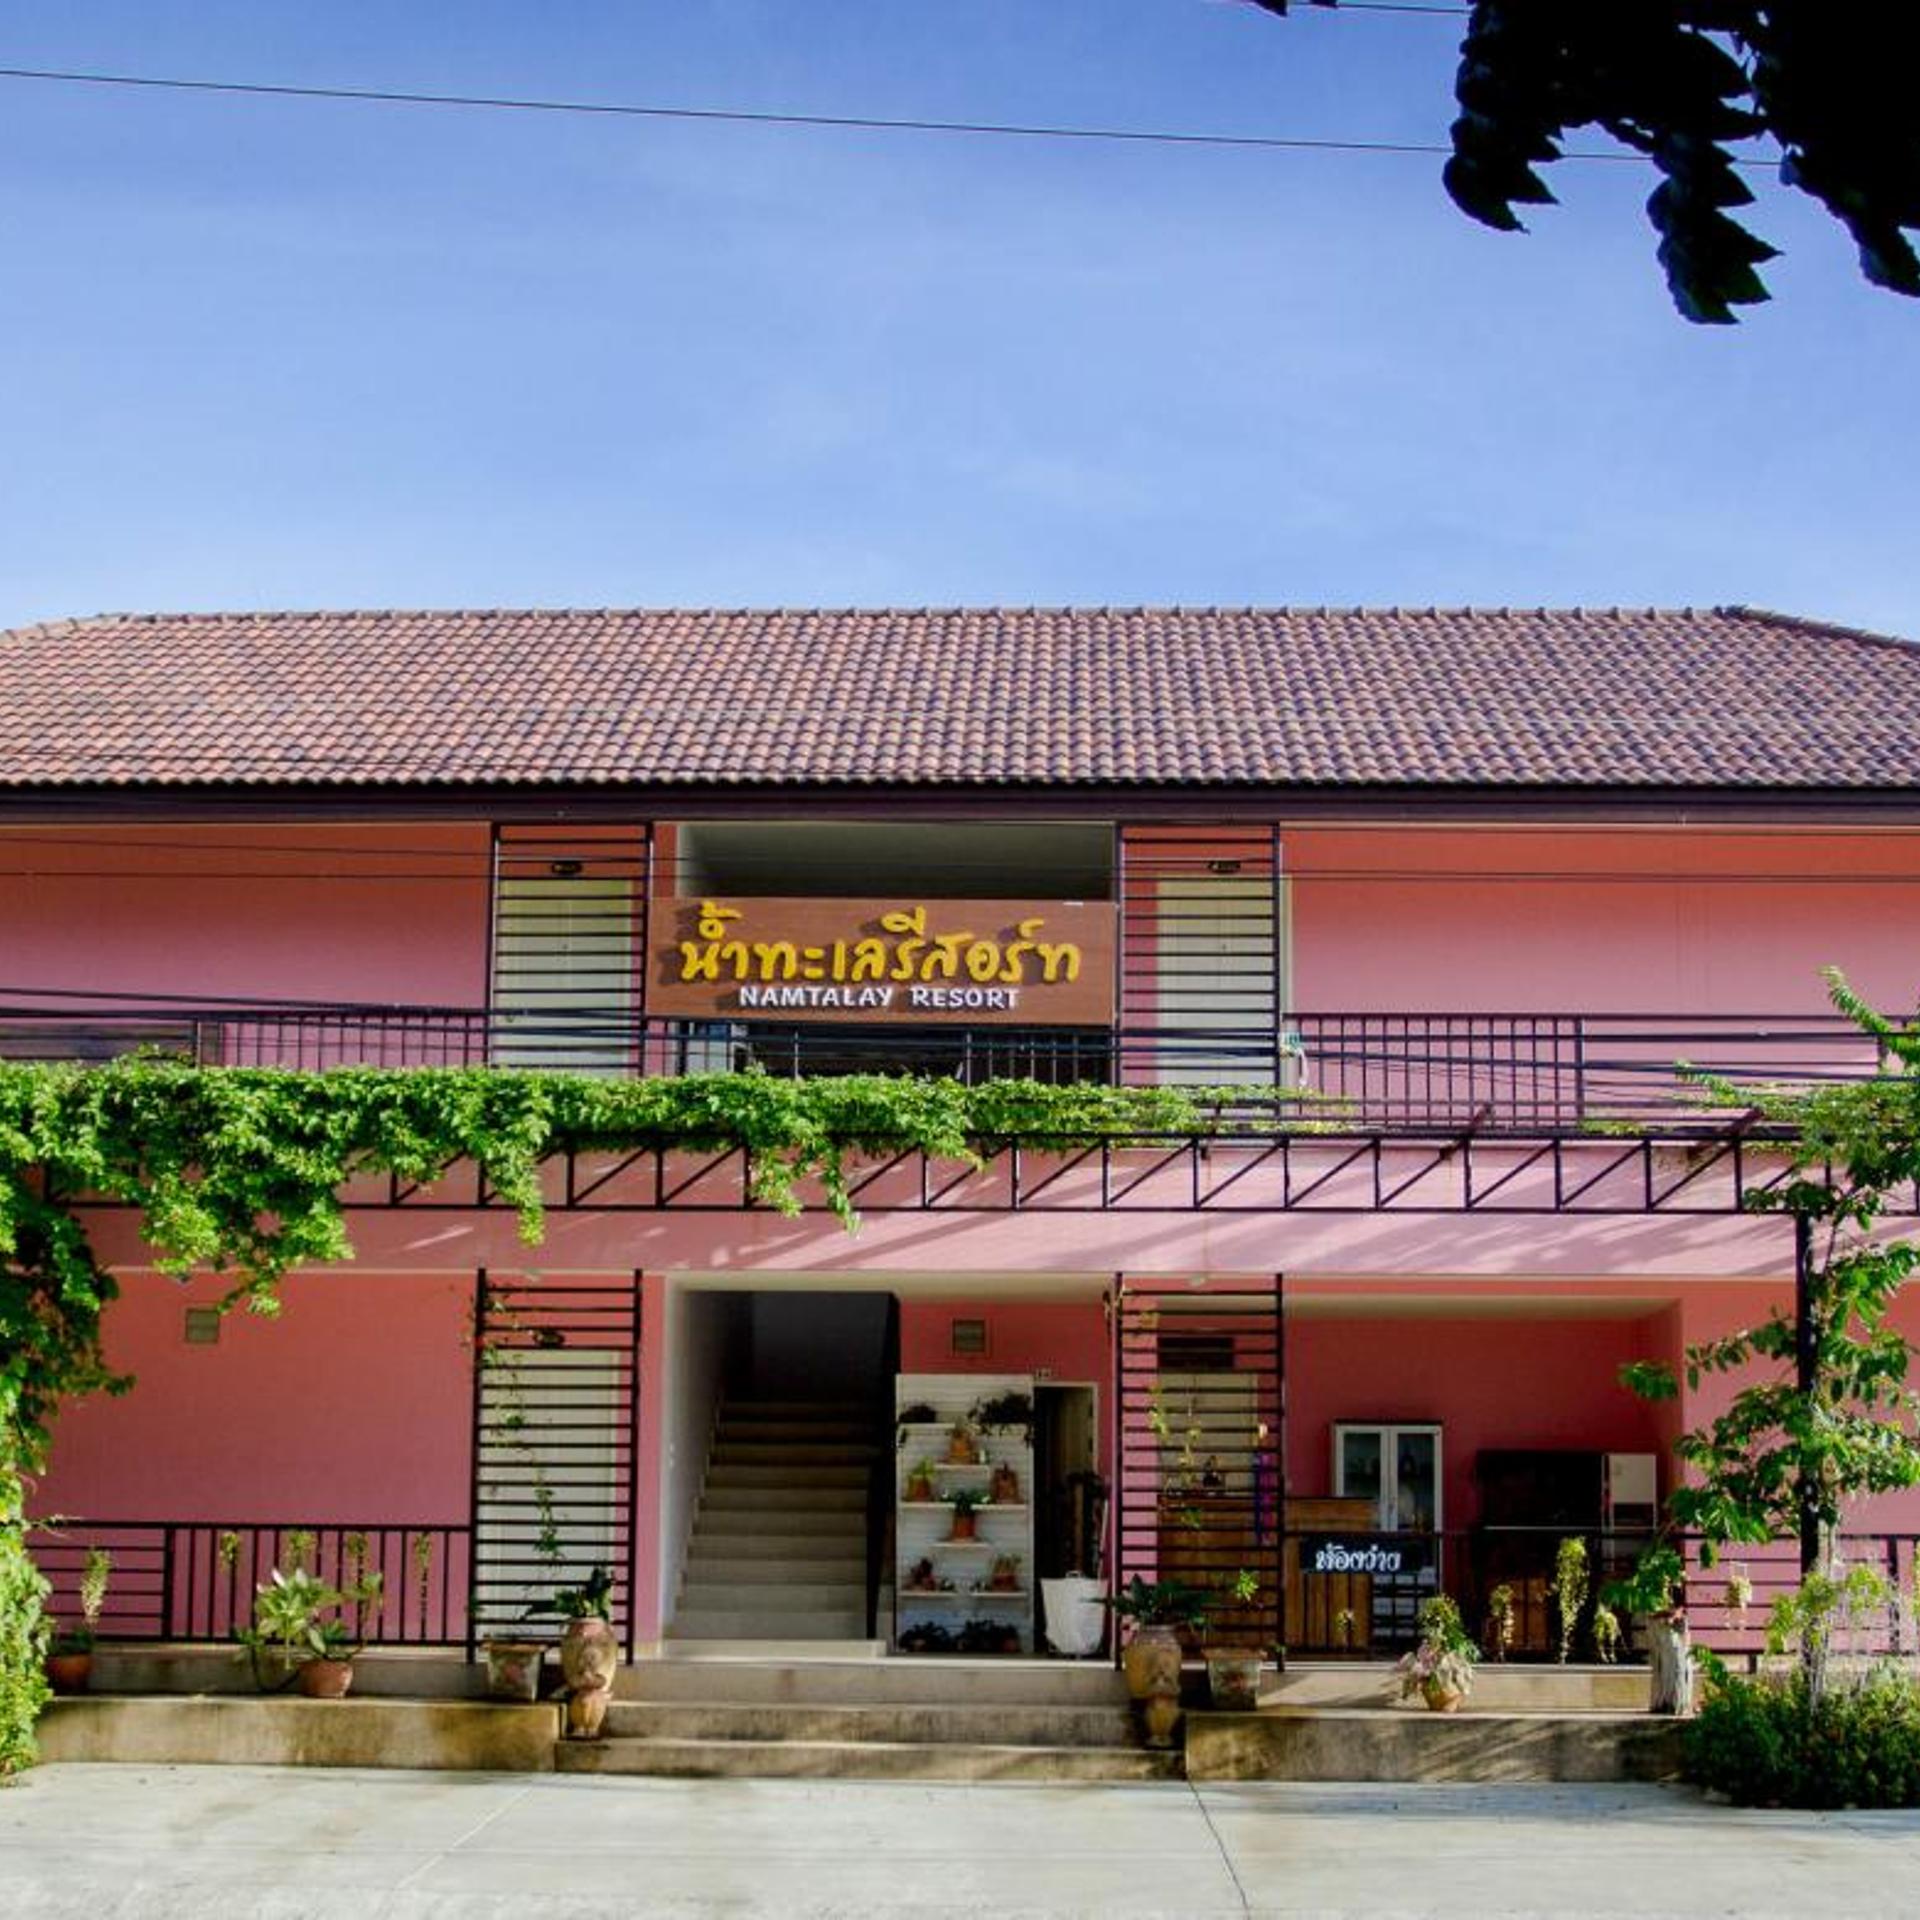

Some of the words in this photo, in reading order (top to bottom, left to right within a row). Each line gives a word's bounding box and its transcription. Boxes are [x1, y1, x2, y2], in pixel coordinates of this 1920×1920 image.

[681, 901, 1081, 982] น้ำทะเลรีสอร์ท
[738, 985, 893, 1008] NAMTALAY
[911, 985, 1020, 1009] RESORT
